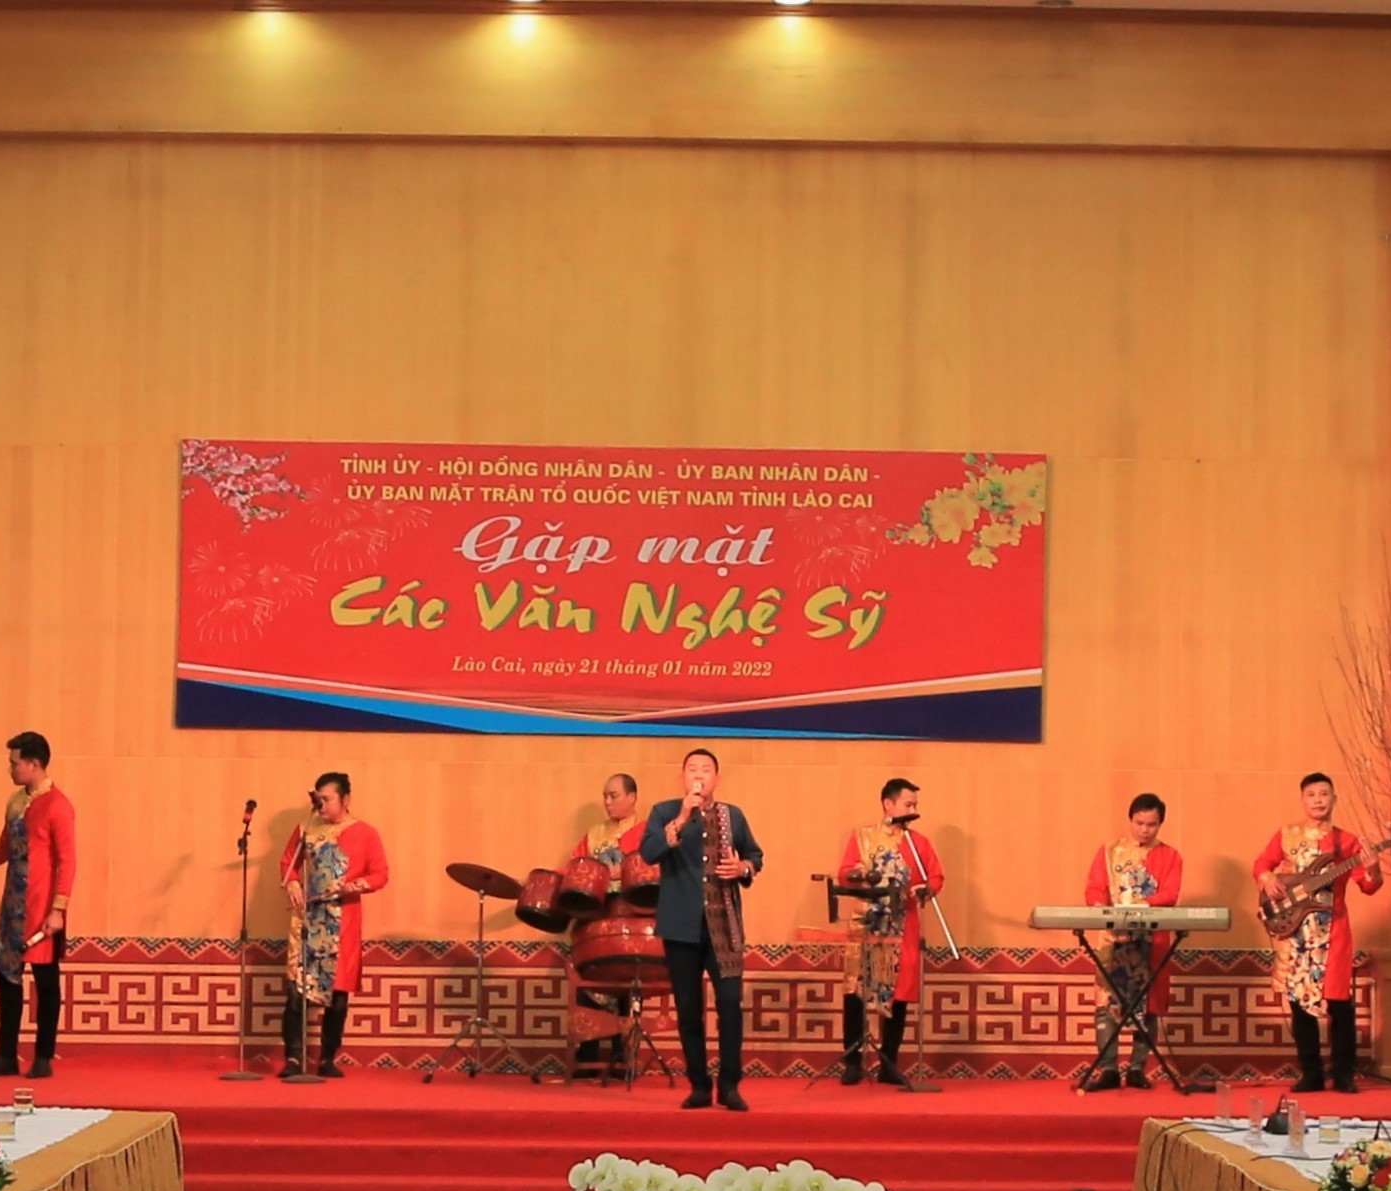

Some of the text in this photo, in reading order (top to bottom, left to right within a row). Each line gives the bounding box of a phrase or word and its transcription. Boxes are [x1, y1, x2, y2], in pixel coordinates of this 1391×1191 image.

[340, 453, 387, 474] TỈNH
[393, 453, 421, 475] ỦY
[439, 456, 473, 480] HỘI
[544, 458, 603, 478] NHÂN
[608, 459, 653, 479] DÂN
[677, 458, 705, 480] ỦY
[711, 465, 754, 481] BAN
[760, 462, 818, 482] NHÂN
[824, 463, 868, 482] DÂN
[347, 479, 873, 509] ỦY BAN MẶT TRẬN TỔ QUỐC VIỆT NAM TỈNH LÀO CAI
[453, 515, 775, 577] Gặp mặt
[330, 576, 888, 650] Các Văn Nghệ Sỹ
[452, 656, 773, 678] Lào Cai, ngày 21 tháng 01 năm 2022
